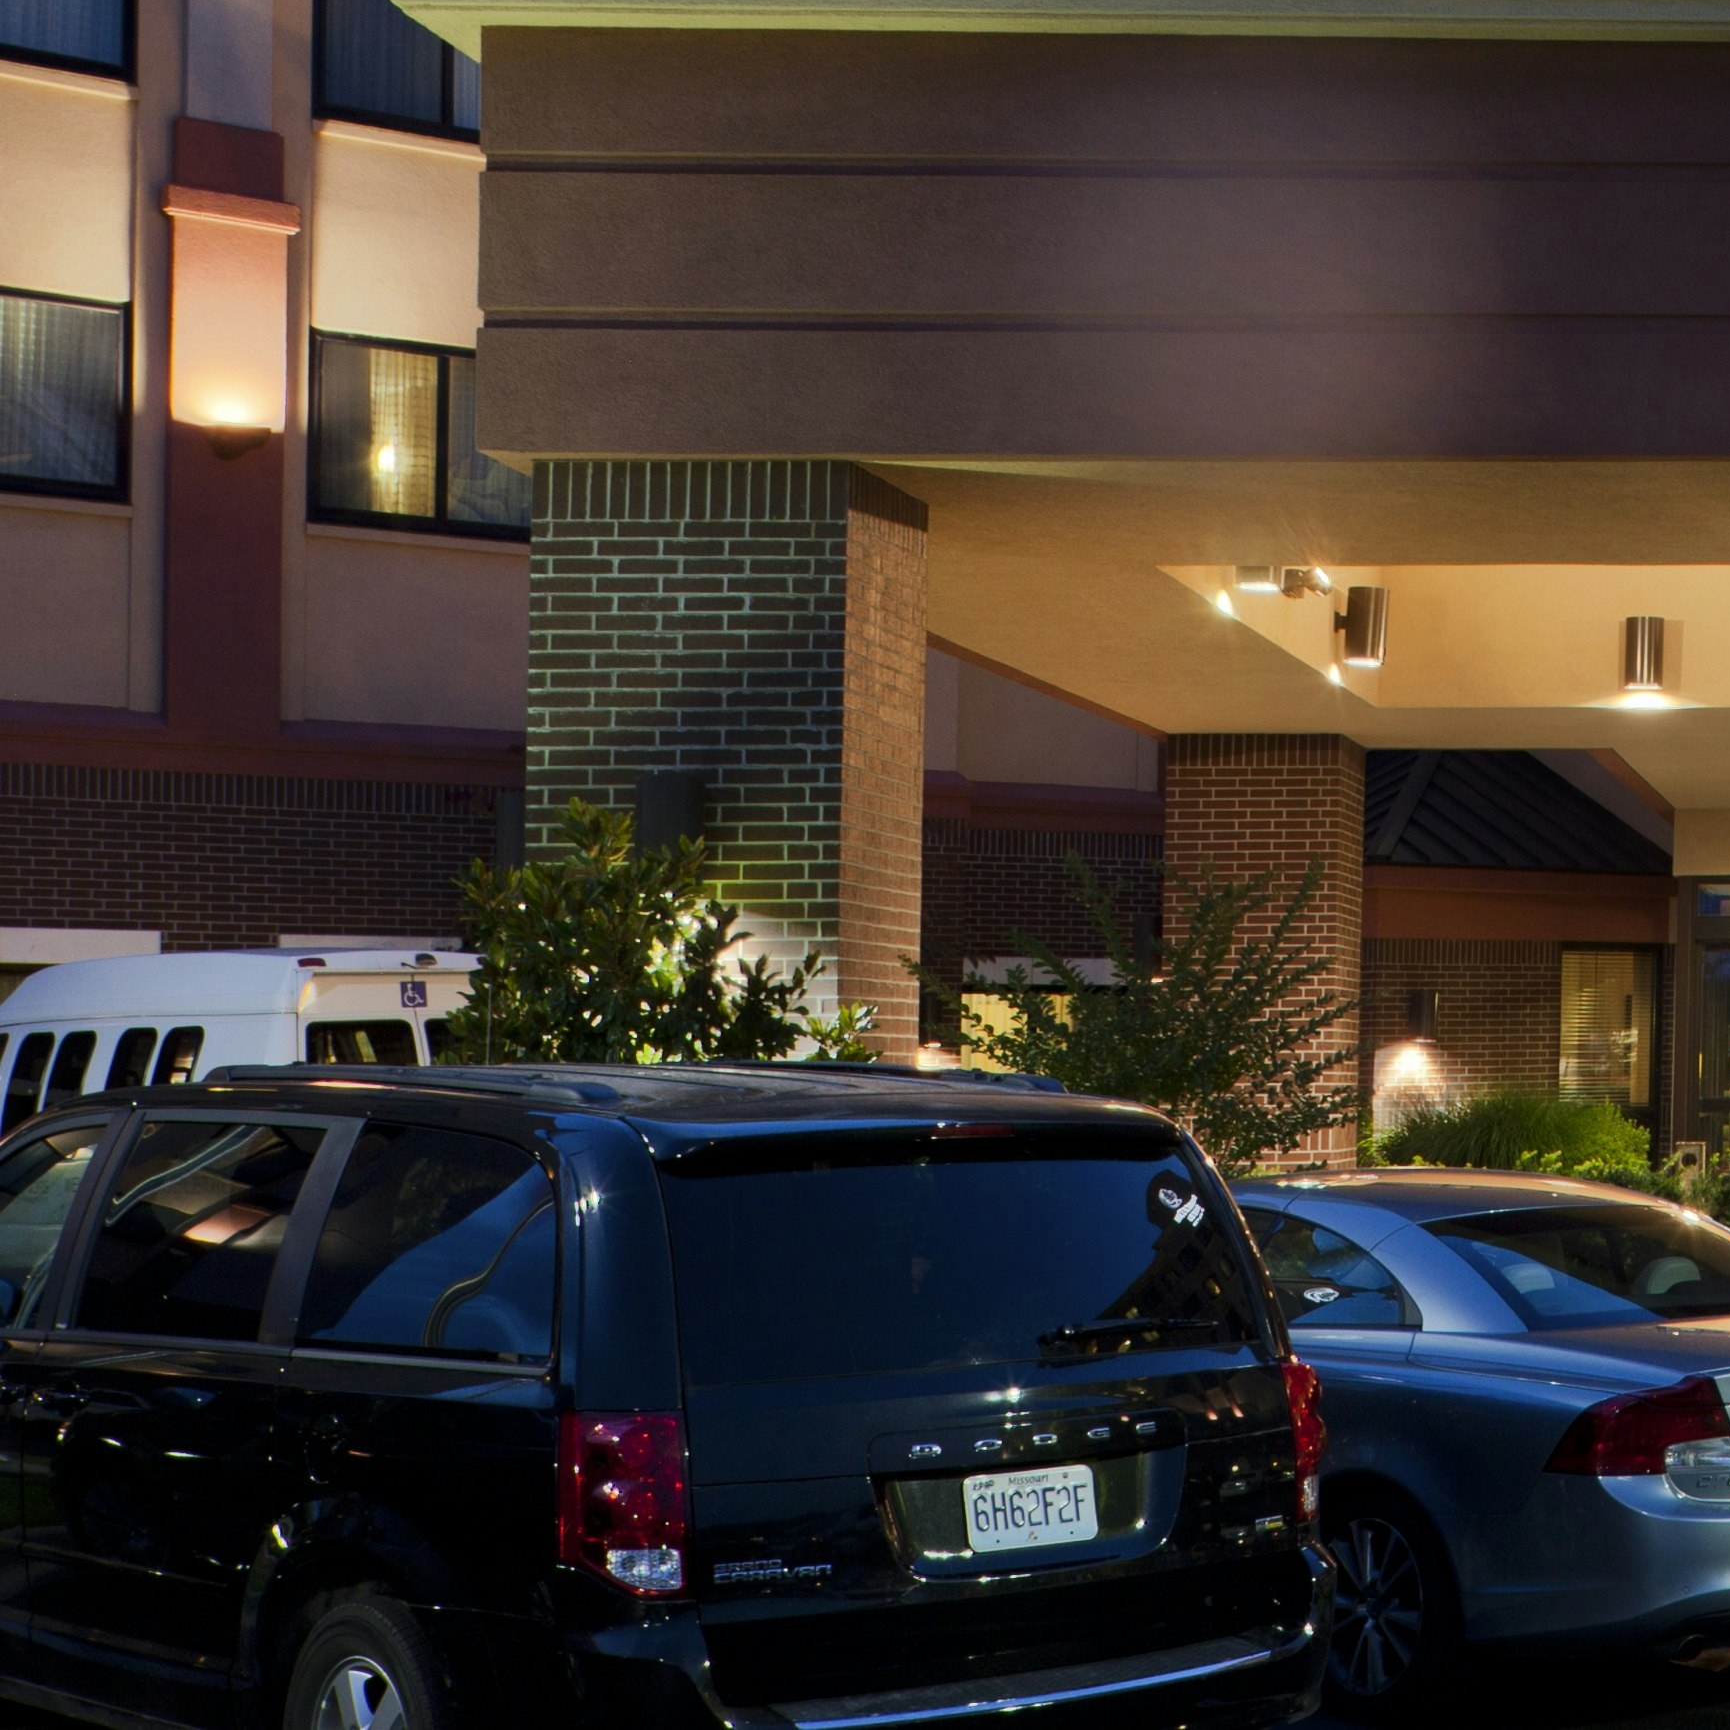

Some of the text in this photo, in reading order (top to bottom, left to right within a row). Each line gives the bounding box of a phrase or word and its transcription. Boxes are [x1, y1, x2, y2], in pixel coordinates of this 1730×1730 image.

[908, 1421, 1156, 1459] DODGE
[1008, 1474, 1049, 1485] Missouri
[973, 1482, 1088, 1533] 6H62F2F
[714, 1564, 832, 1583] CARAVAN
